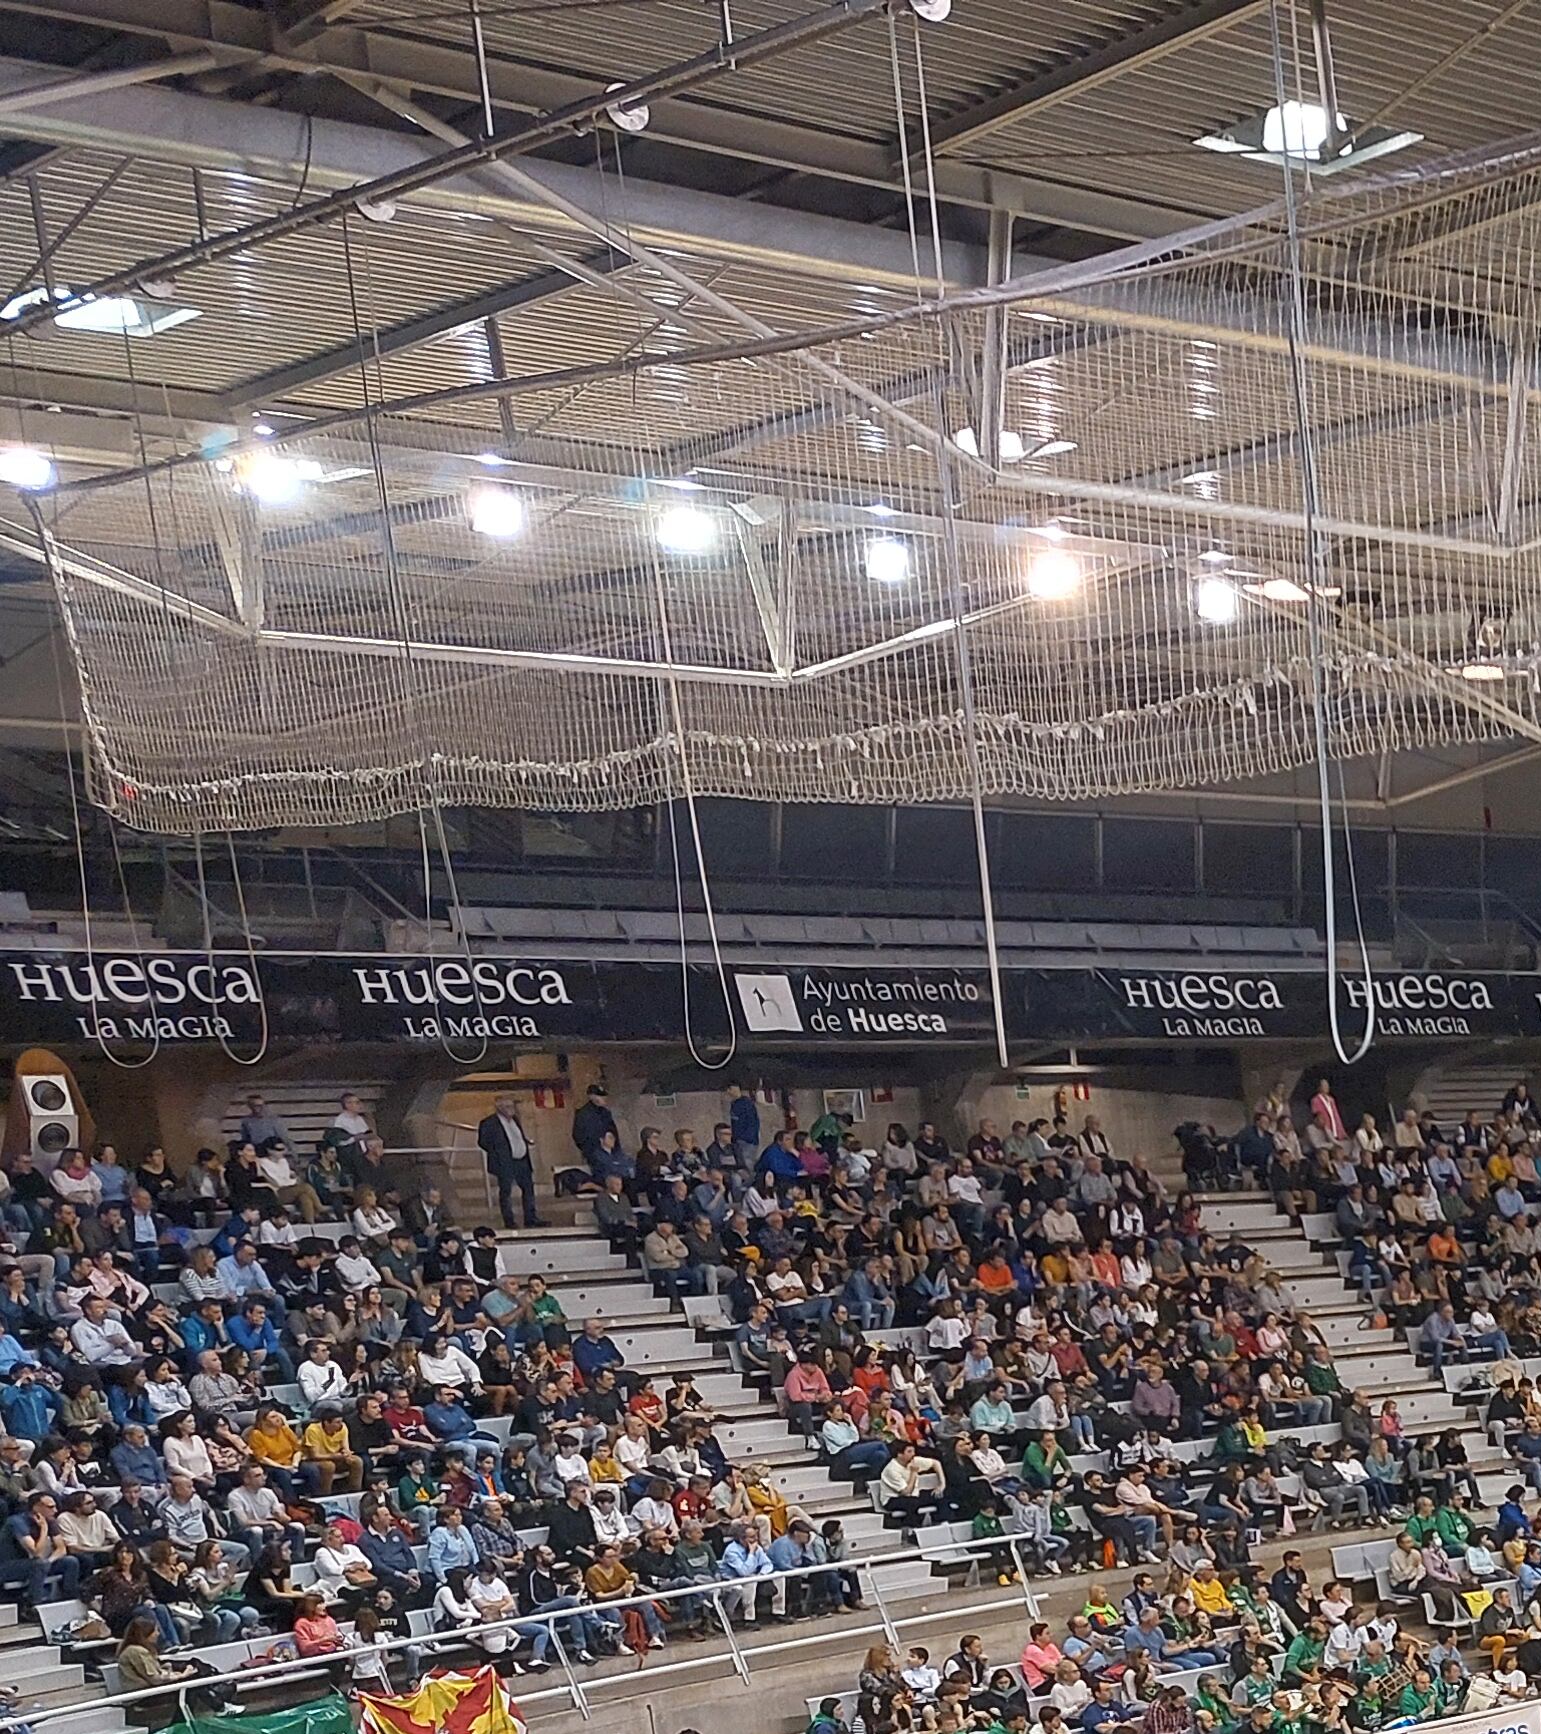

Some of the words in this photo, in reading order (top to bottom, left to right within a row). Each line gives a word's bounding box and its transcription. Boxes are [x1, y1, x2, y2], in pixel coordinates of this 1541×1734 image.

[802, 972, 980, 1003] Ayuntamiento
[810, 1009, 843, 1033] de
[848, 1009, 948, 1034] Huesca
